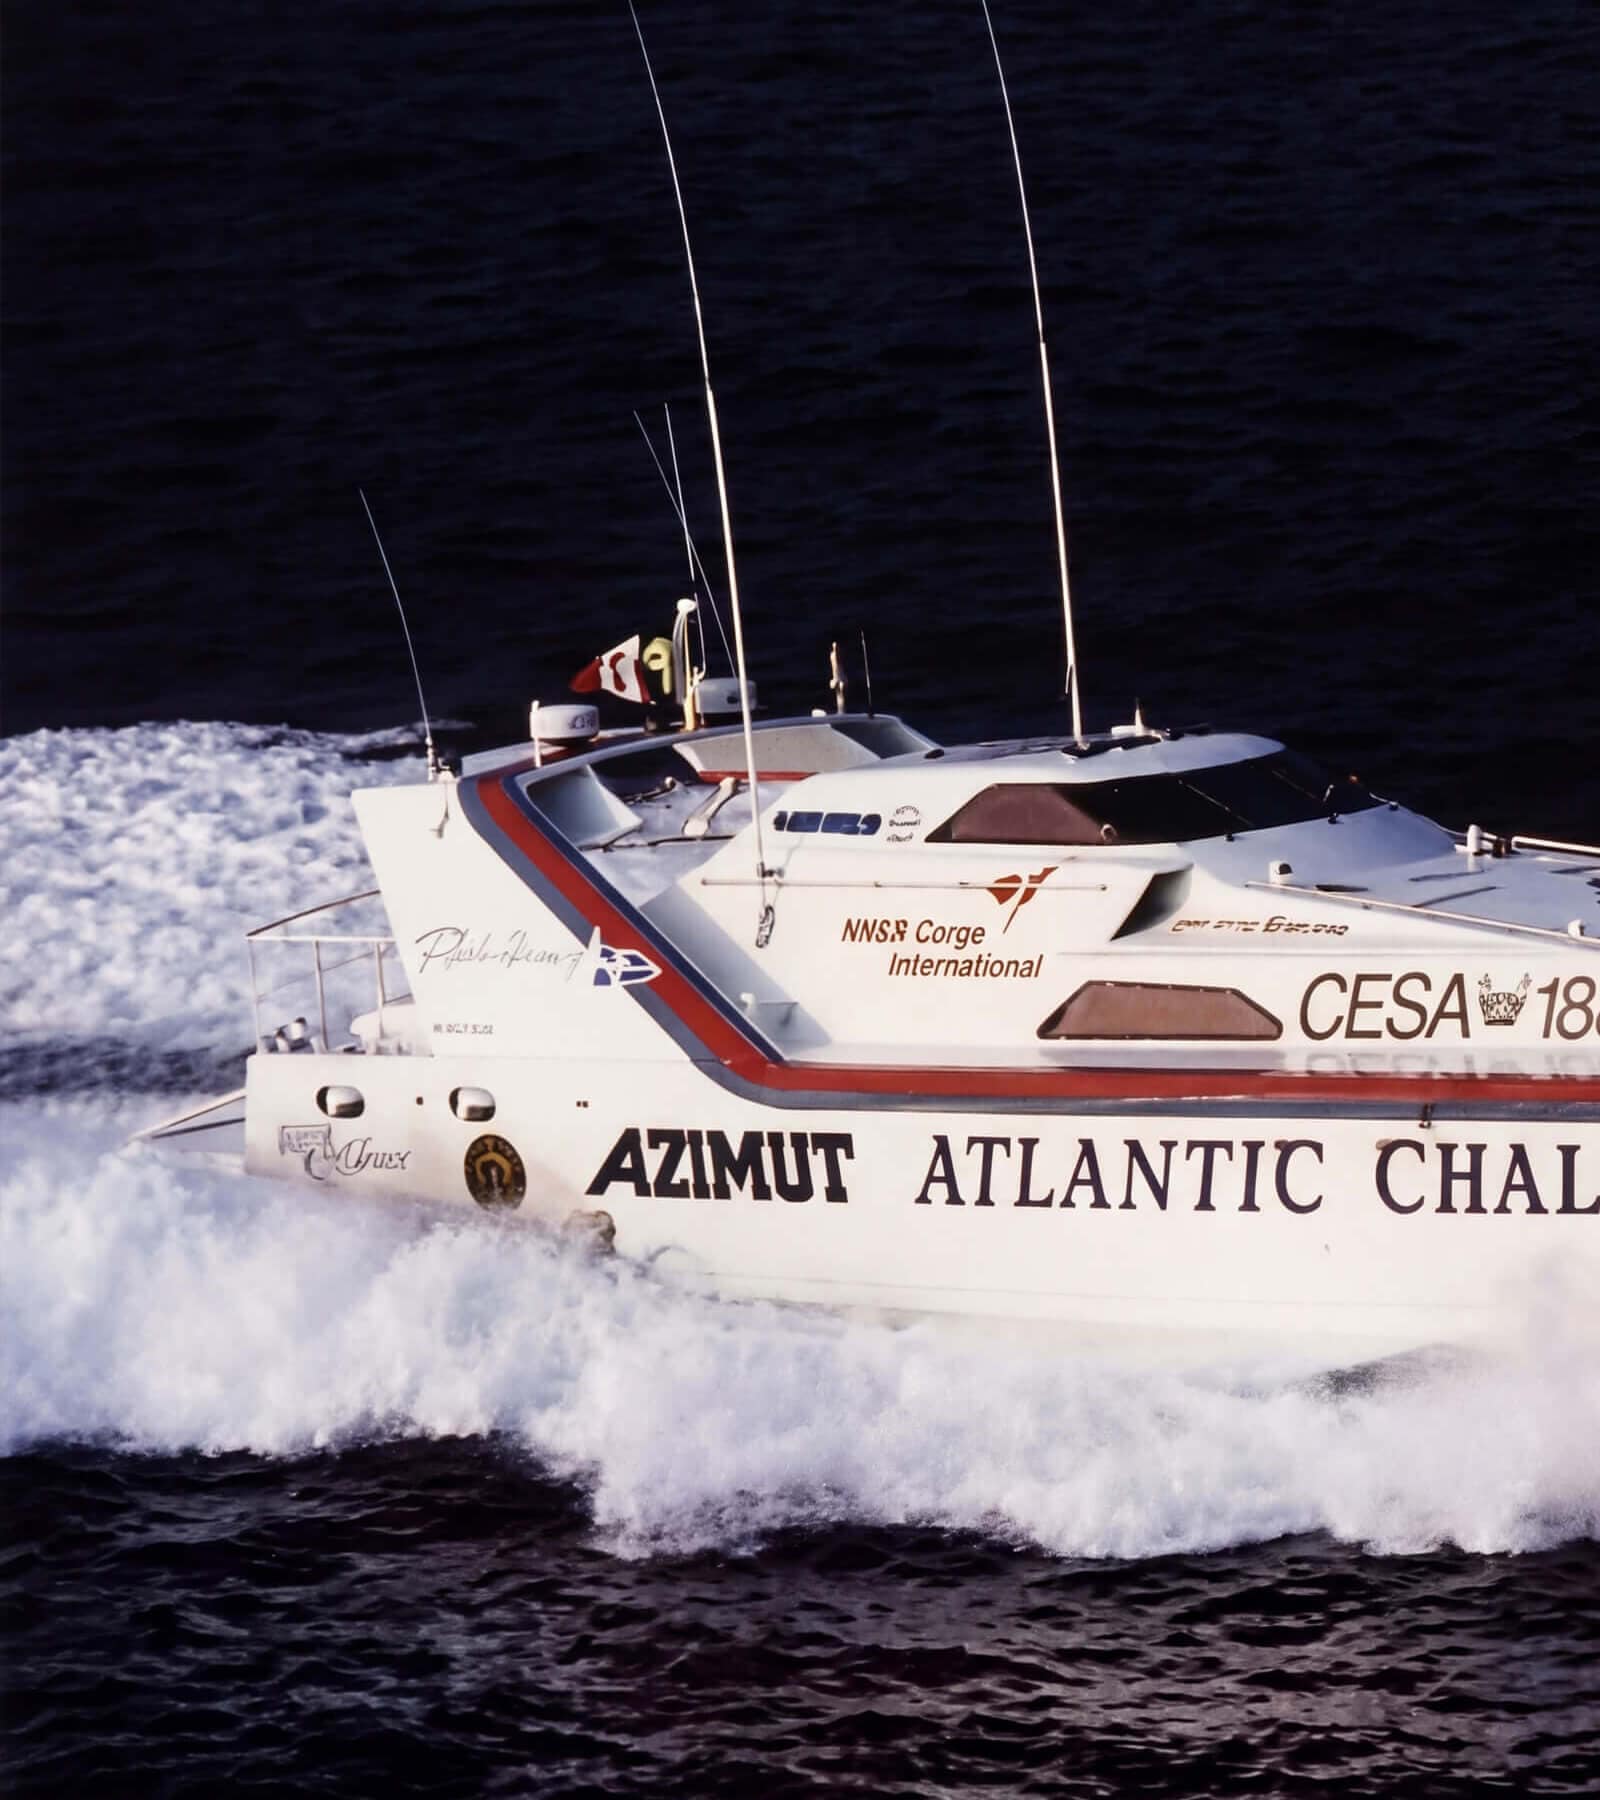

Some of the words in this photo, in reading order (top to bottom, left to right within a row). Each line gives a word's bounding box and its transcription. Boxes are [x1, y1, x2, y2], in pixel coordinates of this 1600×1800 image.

[915, 919, 986, 951] Corge
[888, 952, 1044, 978] International
[1299, 971, 1471, 1041] CESA
[585, 1127, 855, 1204] AZIMUT
[914, 1135, 1324, 1214] ATLANTIC
